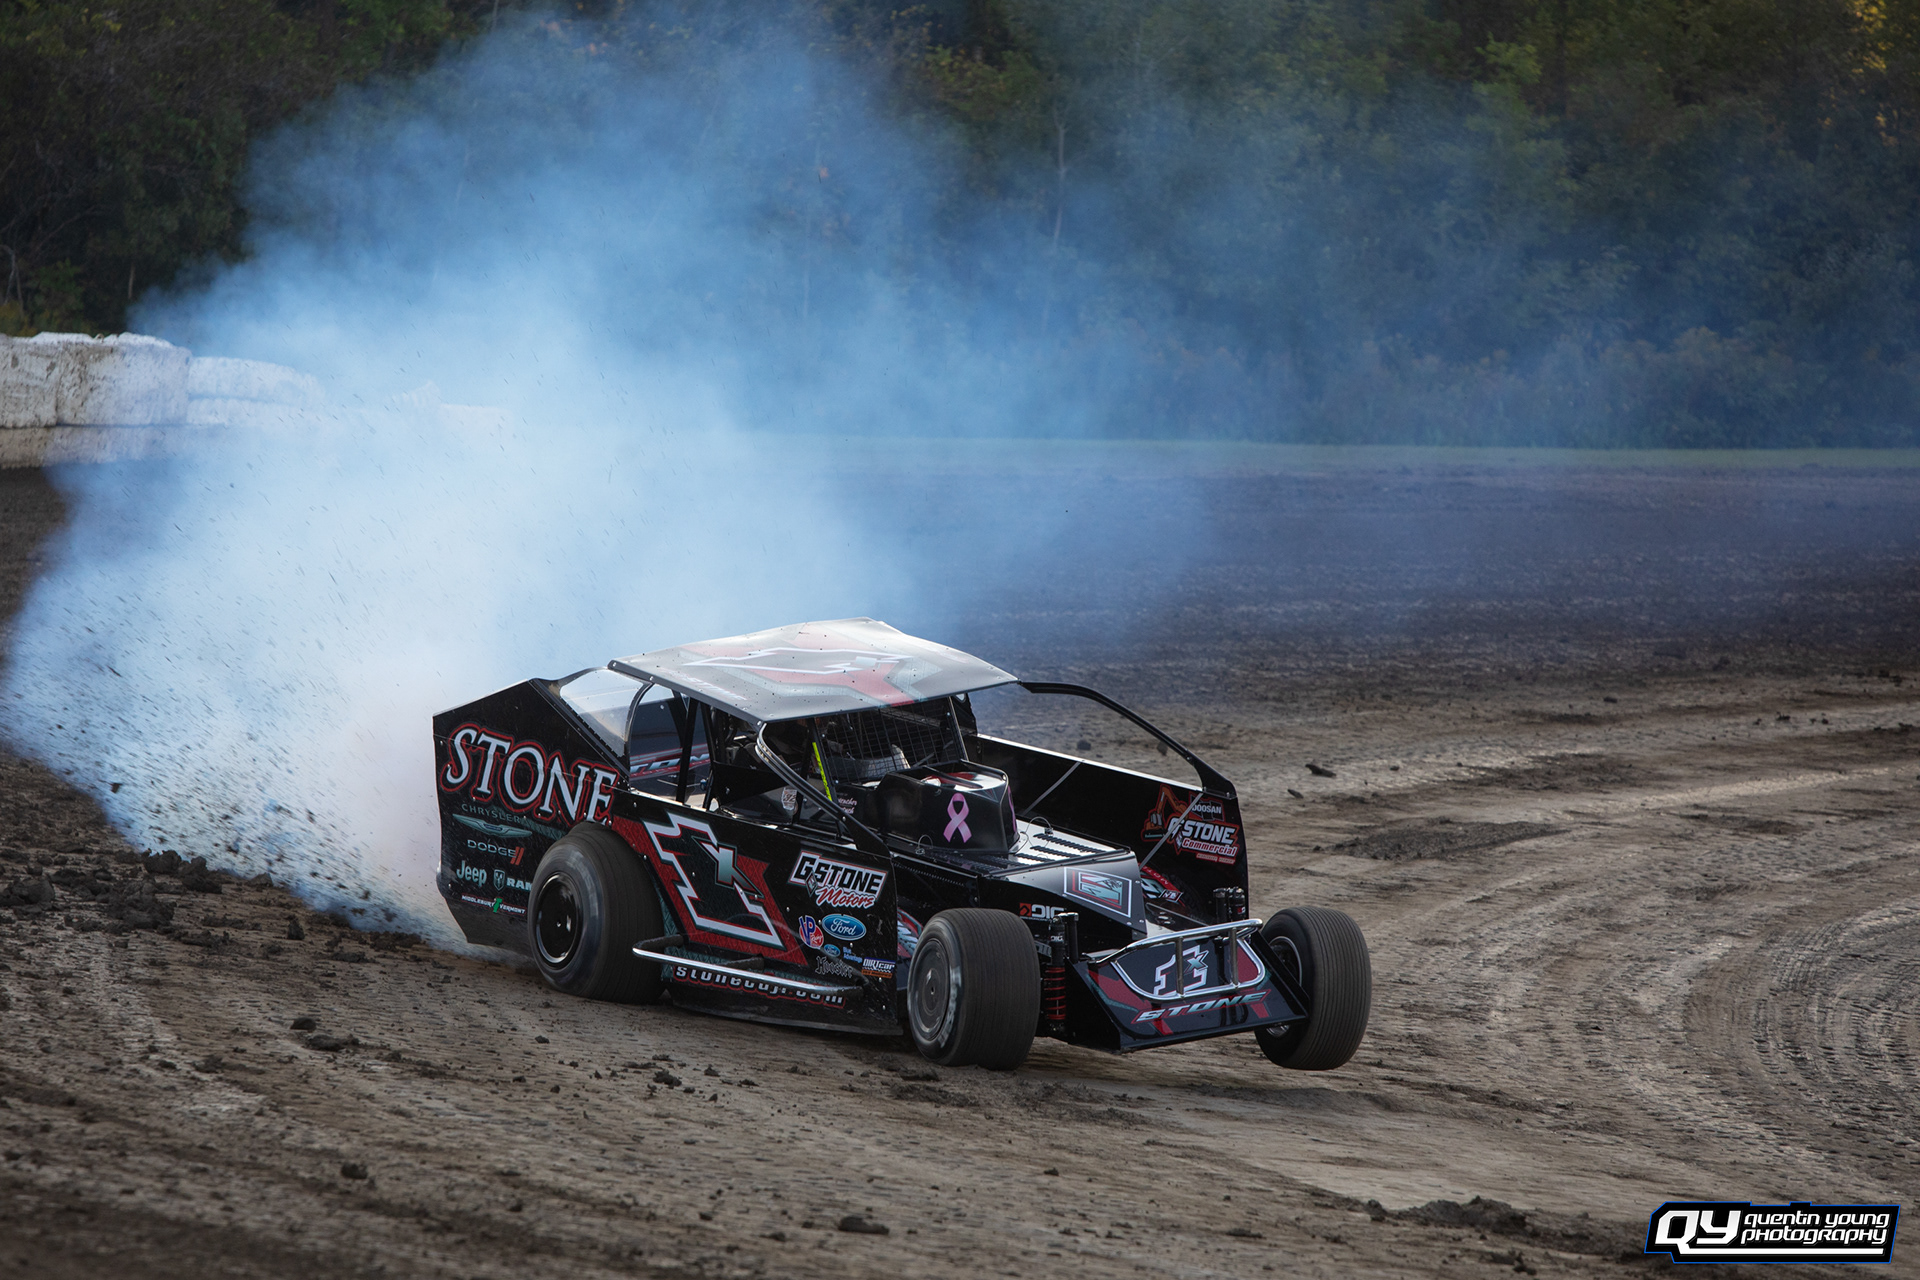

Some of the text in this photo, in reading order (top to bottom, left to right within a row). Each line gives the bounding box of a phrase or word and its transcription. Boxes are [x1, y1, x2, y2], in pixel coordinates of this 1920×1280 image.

[444, 726, 618, 826] STONE
[461, 803, 521, 823] CHRYSLER
[467, 839, 517, 858] DODGE
[1182, 838, 1237, 857] Commercial
[456, 860, 488, 888] Jeep
[815, 886, 877, 908] Motors
[830, 917, 857, 936] Ford
[1135, 990, 1268, 1022] STONE
